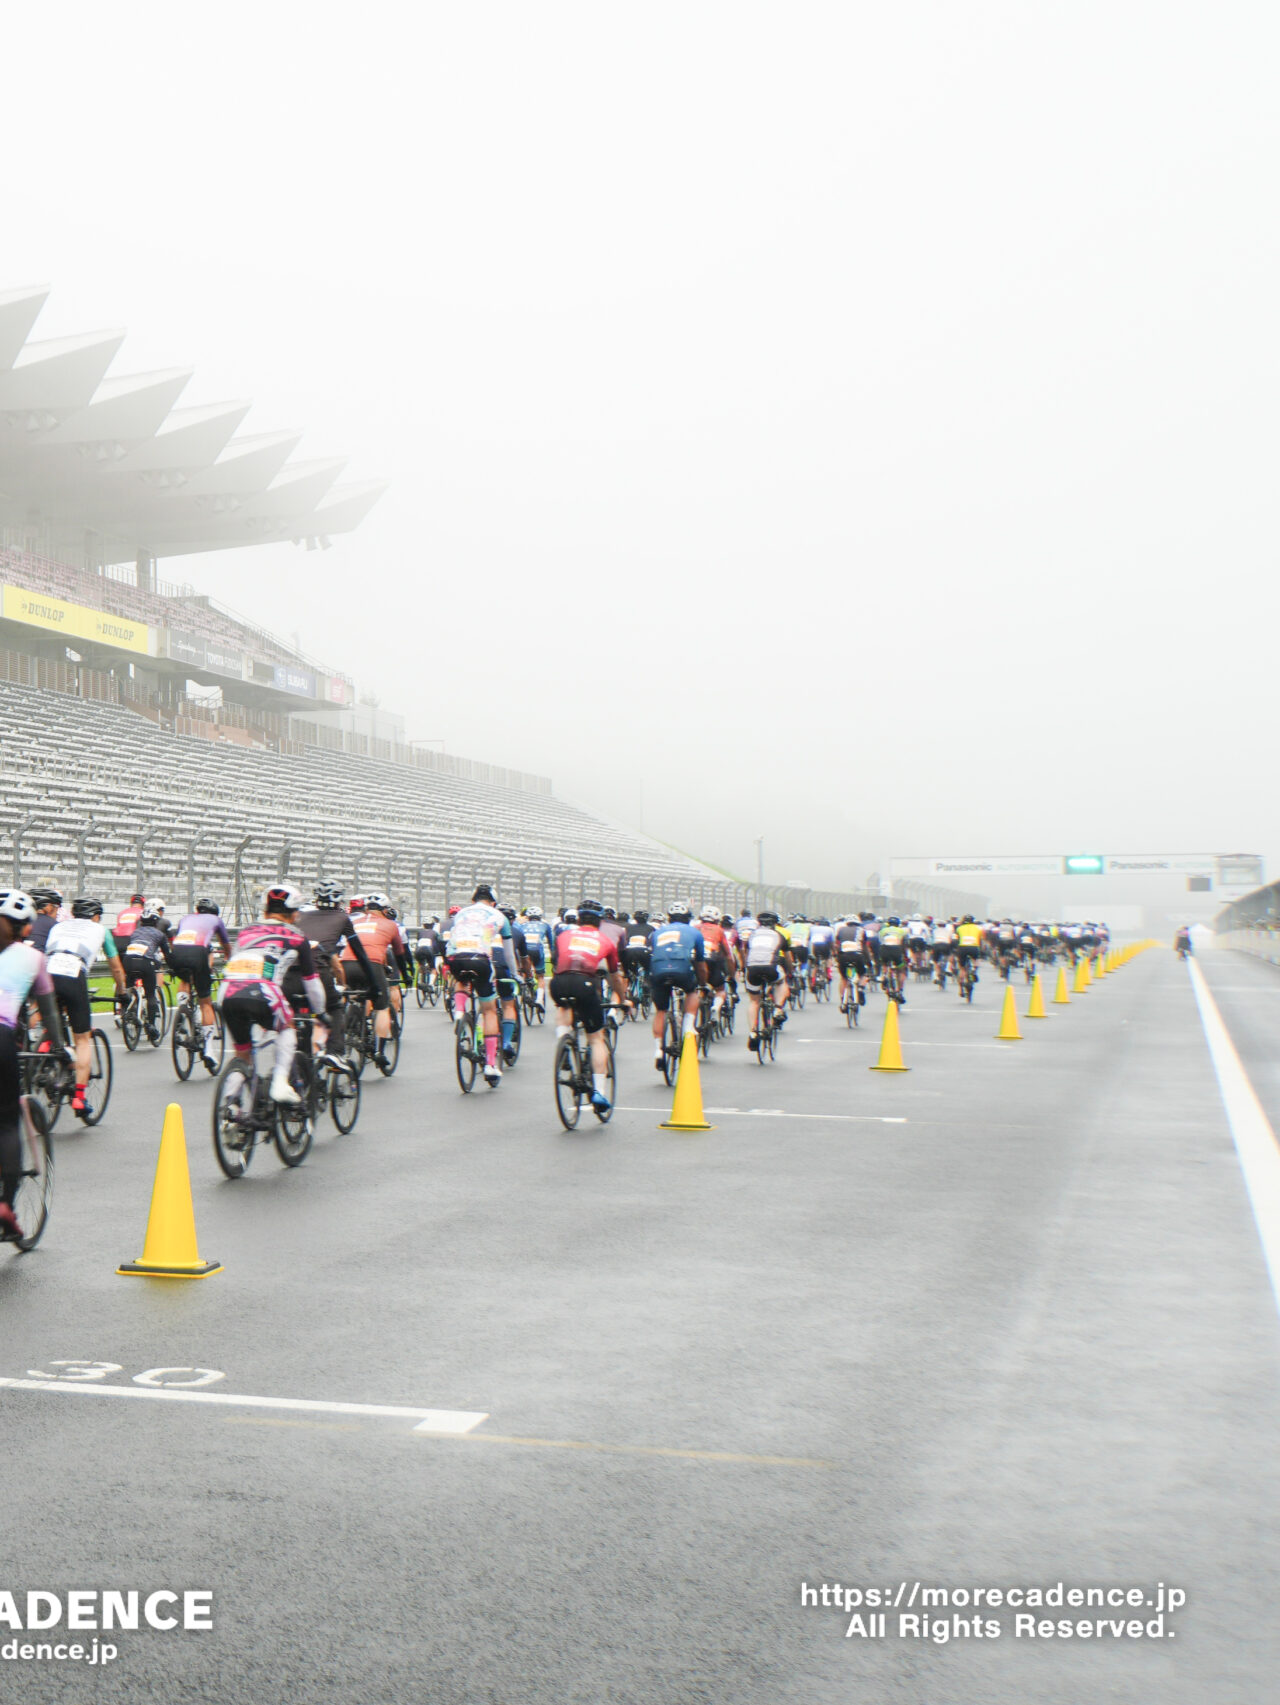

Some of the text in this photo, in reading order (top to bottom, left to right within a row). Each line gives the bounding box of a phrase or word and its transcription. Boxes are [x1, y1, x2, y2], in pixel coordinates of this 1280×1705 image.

[28, 602, 65, 622] DUNLOP
[102, 623, 134, 641] DUNLOP
[936, 862, 992, 871] Panasonic
[1110, 861, 1169, 869] Panasonic
[25, 1359, 226, 1388] 30
